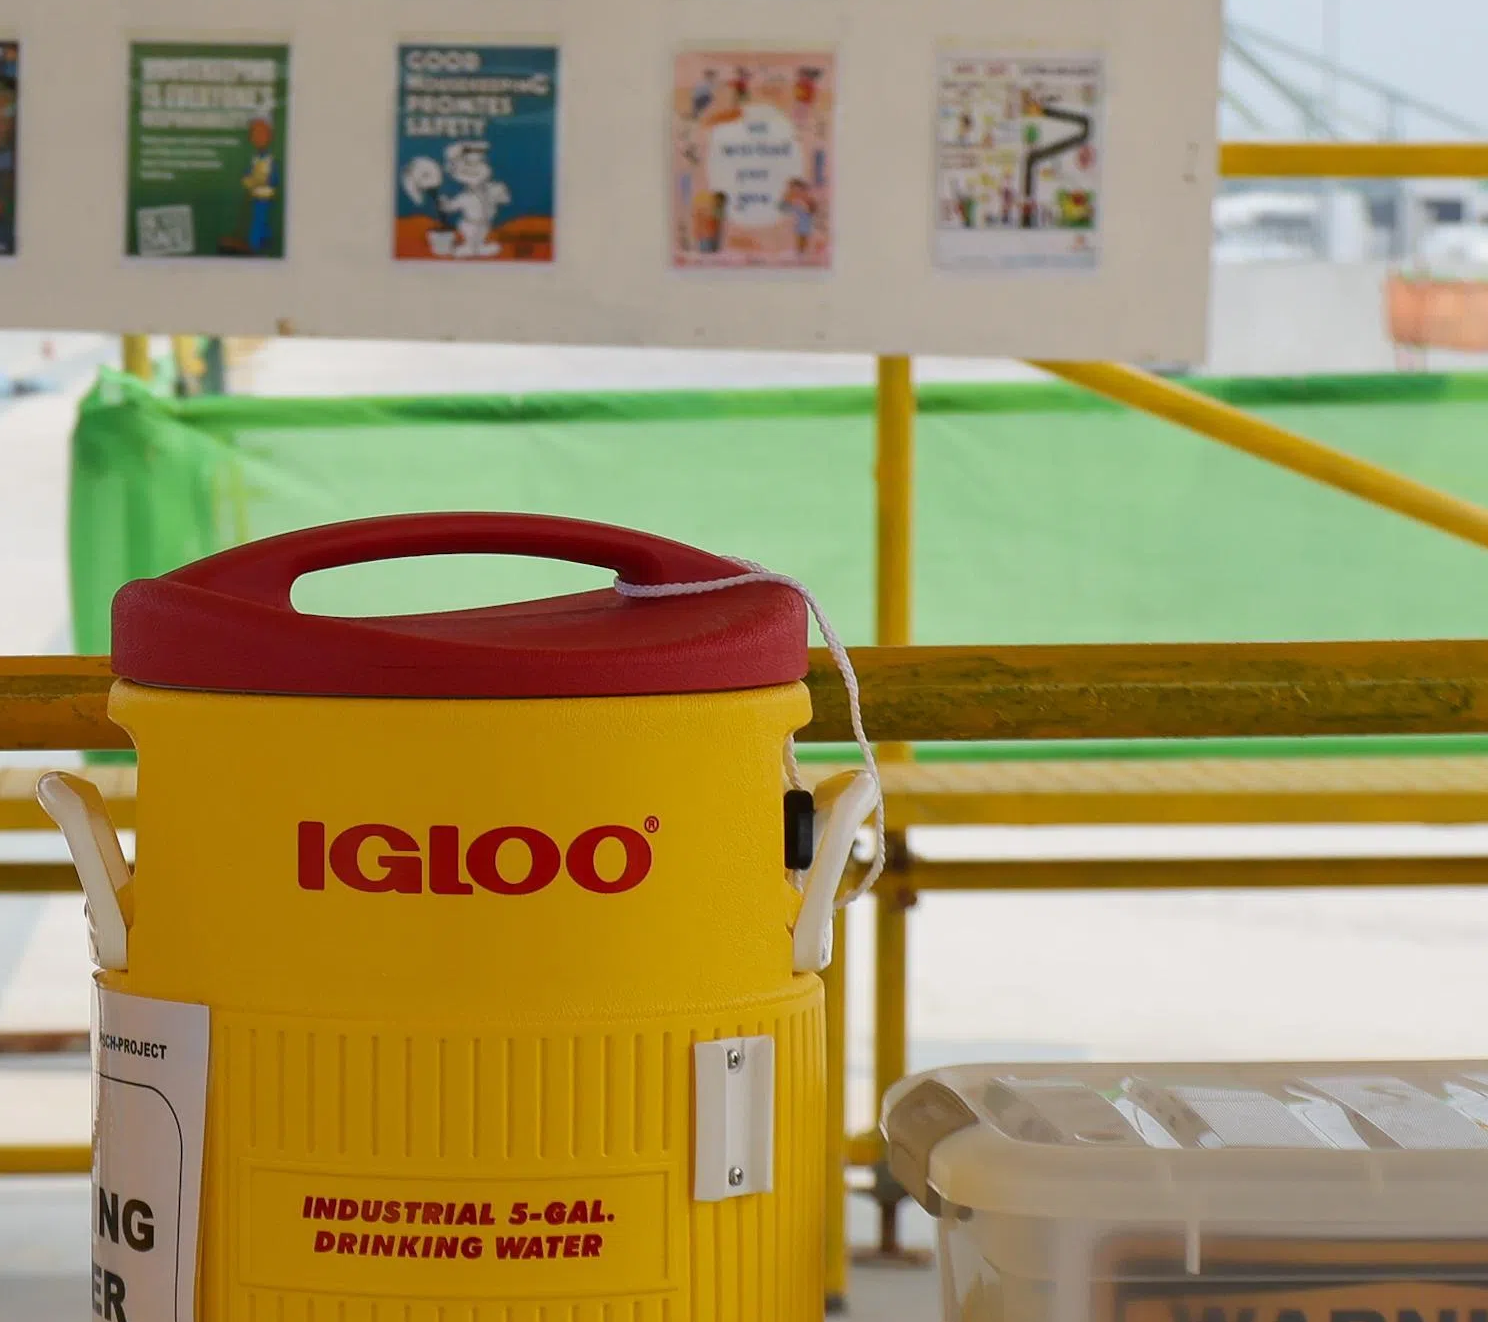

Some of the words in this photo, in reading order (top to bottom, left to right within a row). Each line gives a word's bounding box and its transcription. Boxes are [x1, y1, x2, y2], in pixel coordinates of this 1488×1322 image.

[405, 115, 485, 138] SAFETY
[301, 1195, 497, 1226] INDUSTRIAL
[507, 1198, 616, 1226] 5-GAL.
[313, 1229, 484, 1260] DRINKING
[494, 1233, 604, 1260] WATER
